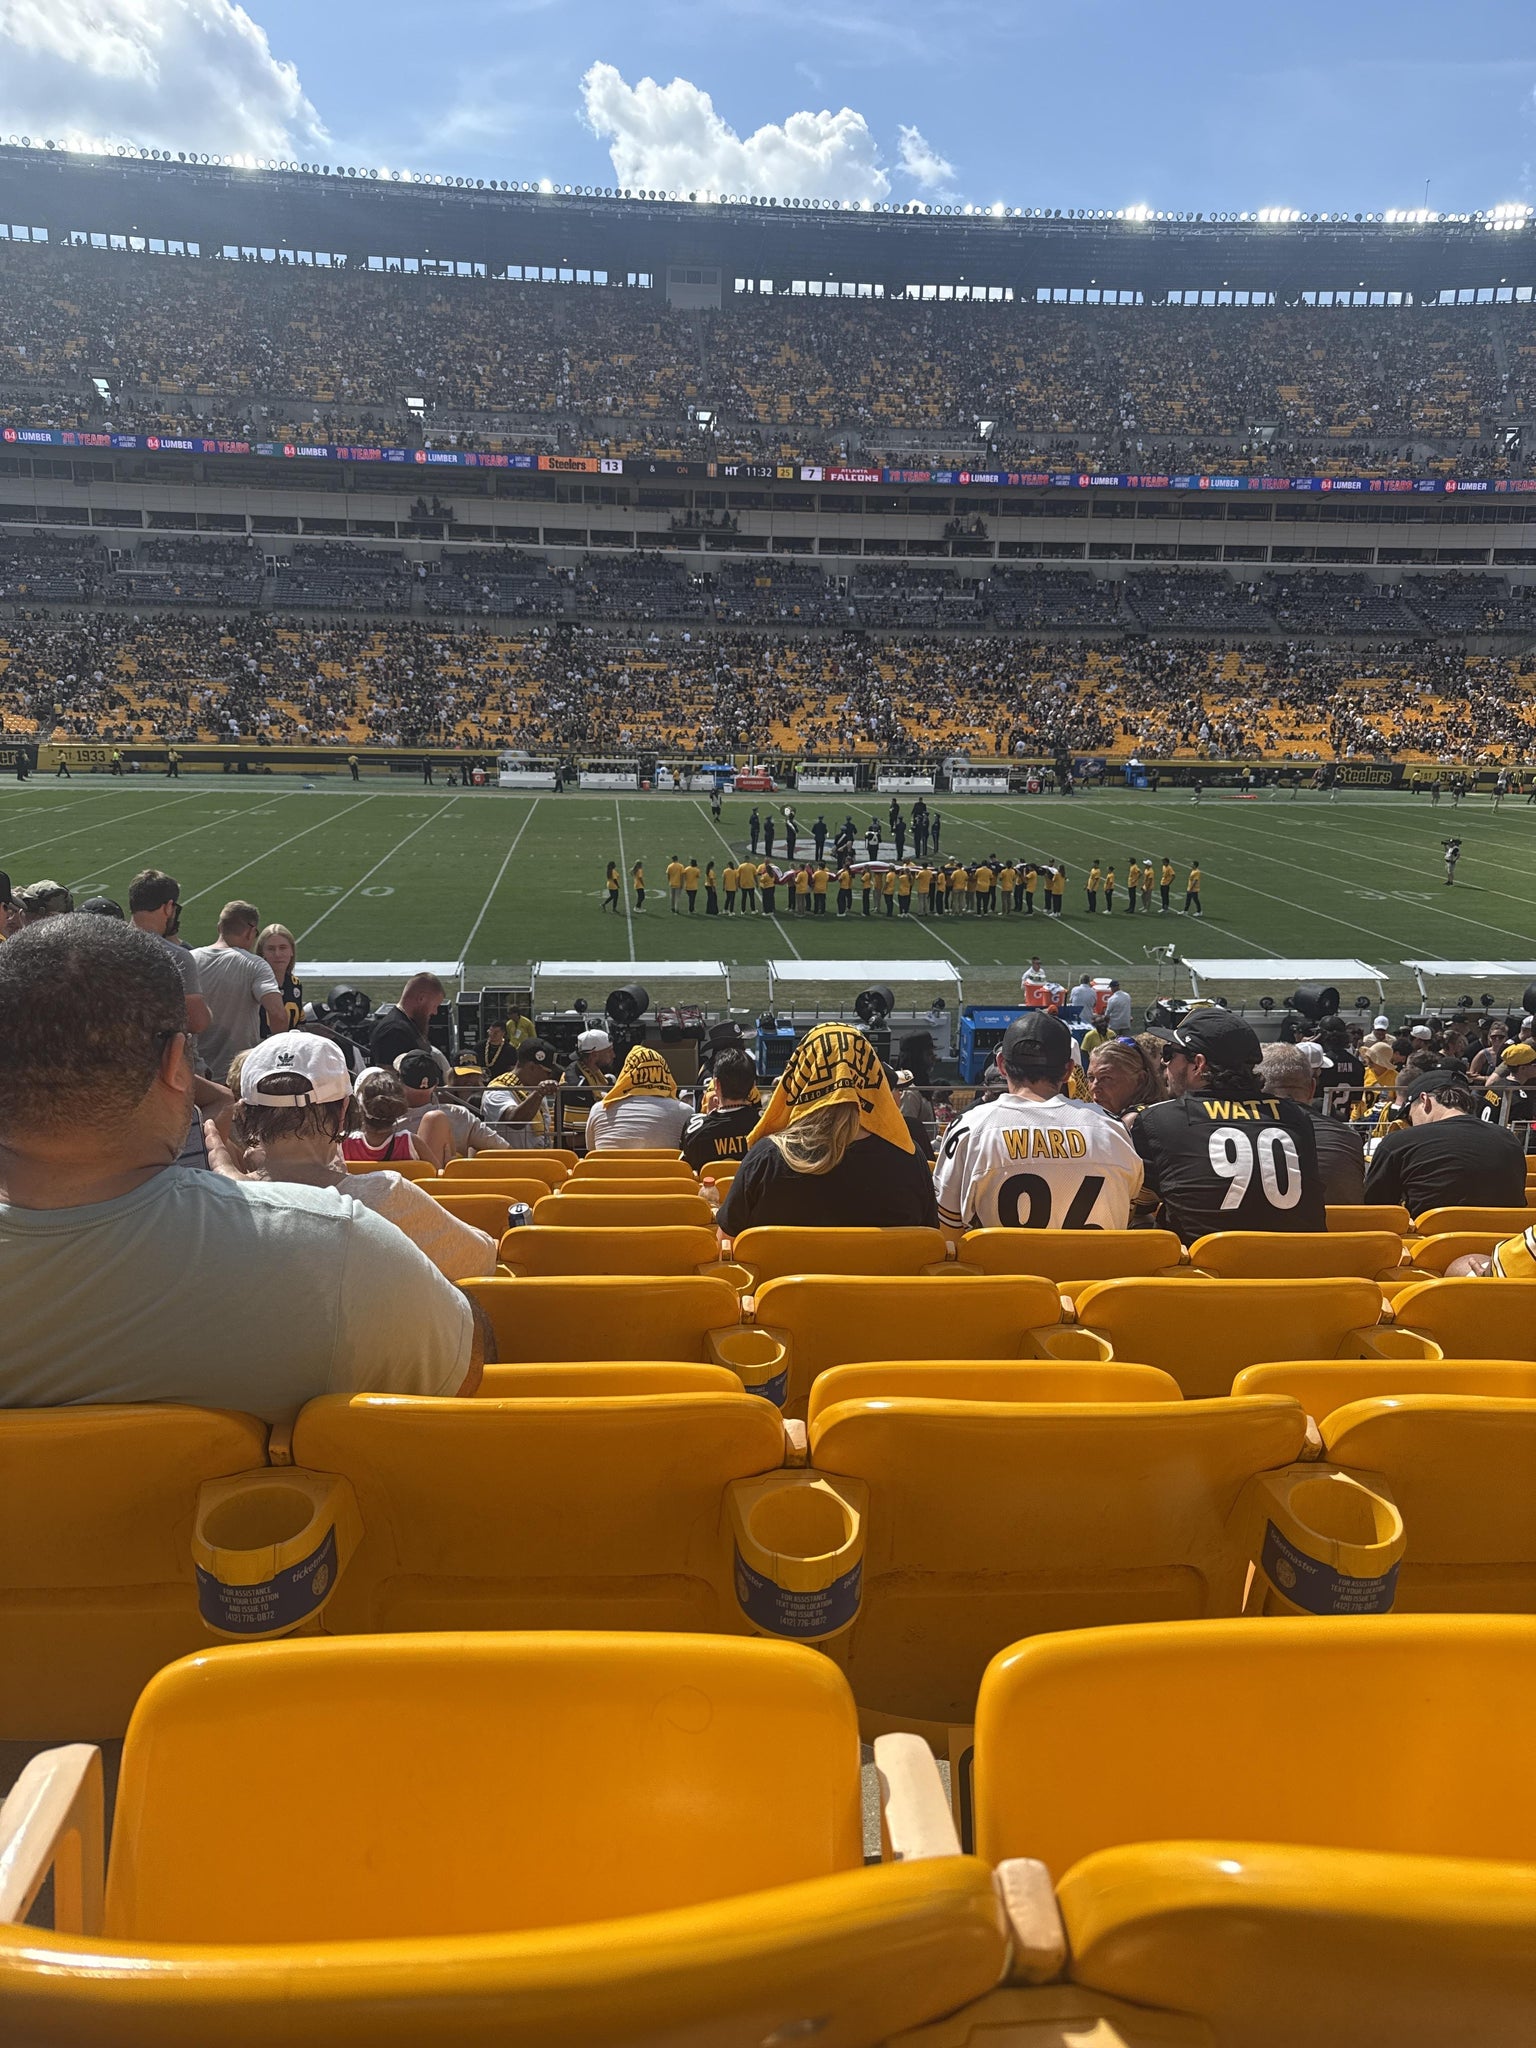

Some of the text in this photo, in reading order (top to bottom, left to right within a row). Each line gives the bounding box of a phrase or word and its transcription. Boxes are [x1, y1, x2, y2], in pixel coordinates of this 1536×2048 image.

[18, 432, 51, 442] LUMBER
[77, 432, 111, 447] YEARS
[161, 440, 193, 450] LUMBER
[217, 441, 249, 454] YEARS
[297, 446, 328, 457] LUMBER
[350, 448, 381, 460] YEARS
[428, 453, 458, 463] LUMBER
[479, 454, 508, 467] YEARS
[548, 457, 587, 471] Steelers
[606, 461, 619, 471] 13
[649, 465, 656, 473] &
[676, 466, 689, 474] ON
[725, 466, 772, 477] HT 11:32
[780, 468, 790, 477] 25
[808, 469, 816, 478] 7
[830, 473, 879, 482] FALCONS
[971, 474, 999, 483] LUMBER
[1091, 477, 1119, 486] LUMBER
[1211, 479, 1239, 487] LUMBER
[1333, 481, 1361, 489] LUMBER
[1458, 482, 1487, 491] LUMBER
[77, 750, 106, 762] 1933
[1335, 766, 1392, 785] Steelers
[302, 885, 396, 897] 30
[1203, 1099, 1281, 1120] WATT
[1002, 1128, 1087, 1160] WARD
[1208, 1126, 1302, 1210] 90
[223, 1586, 271, 1596] FOR ASSISTANCE
[220, 1592, 279, 1605] TEXT YOUR LOCATION
[794, 1593, 827, 1602] ASSISTANCE
[229, 1603, 269, 1613] AND ISSUE TO
[806, 1599, 832, 1610] LOCATION
